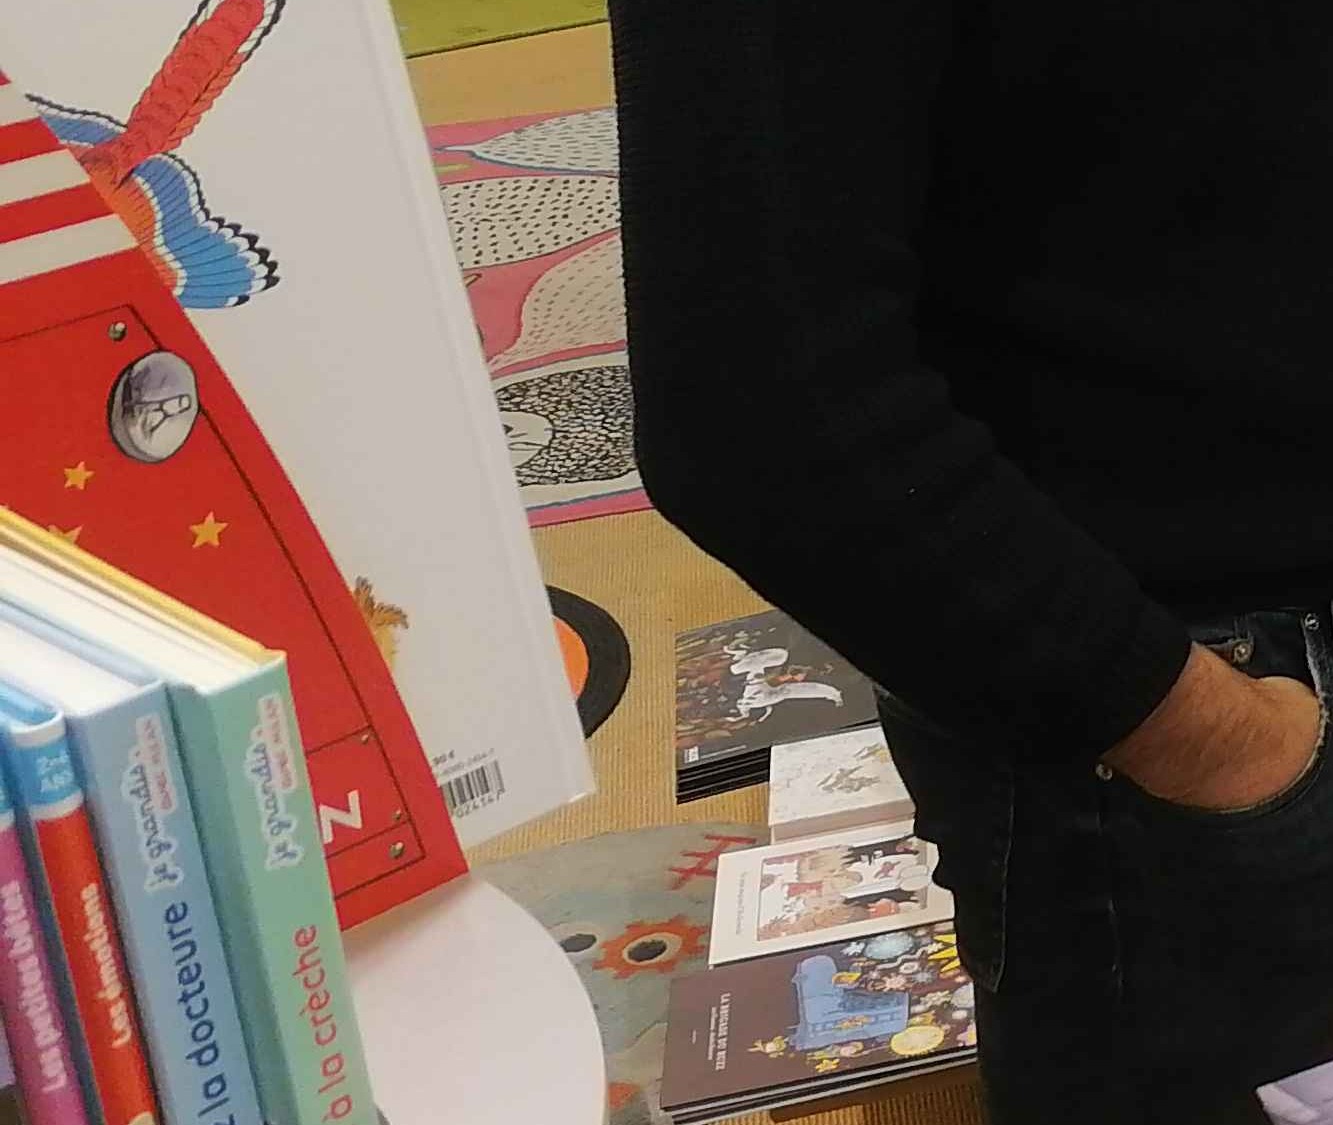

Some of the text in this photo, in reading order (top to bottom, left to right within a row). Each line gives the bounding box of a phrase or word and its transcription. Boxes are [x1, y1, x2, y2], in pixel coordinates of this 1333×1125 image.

[1, 880, 68, 1093] Les petites bêtes
[81, 883, 132, 1049] Les émotions
[165, 900, 220, 1068] docteure
[293, 923, 353, 1123] à la crèche
[202, 1077, 231, 1119] la
